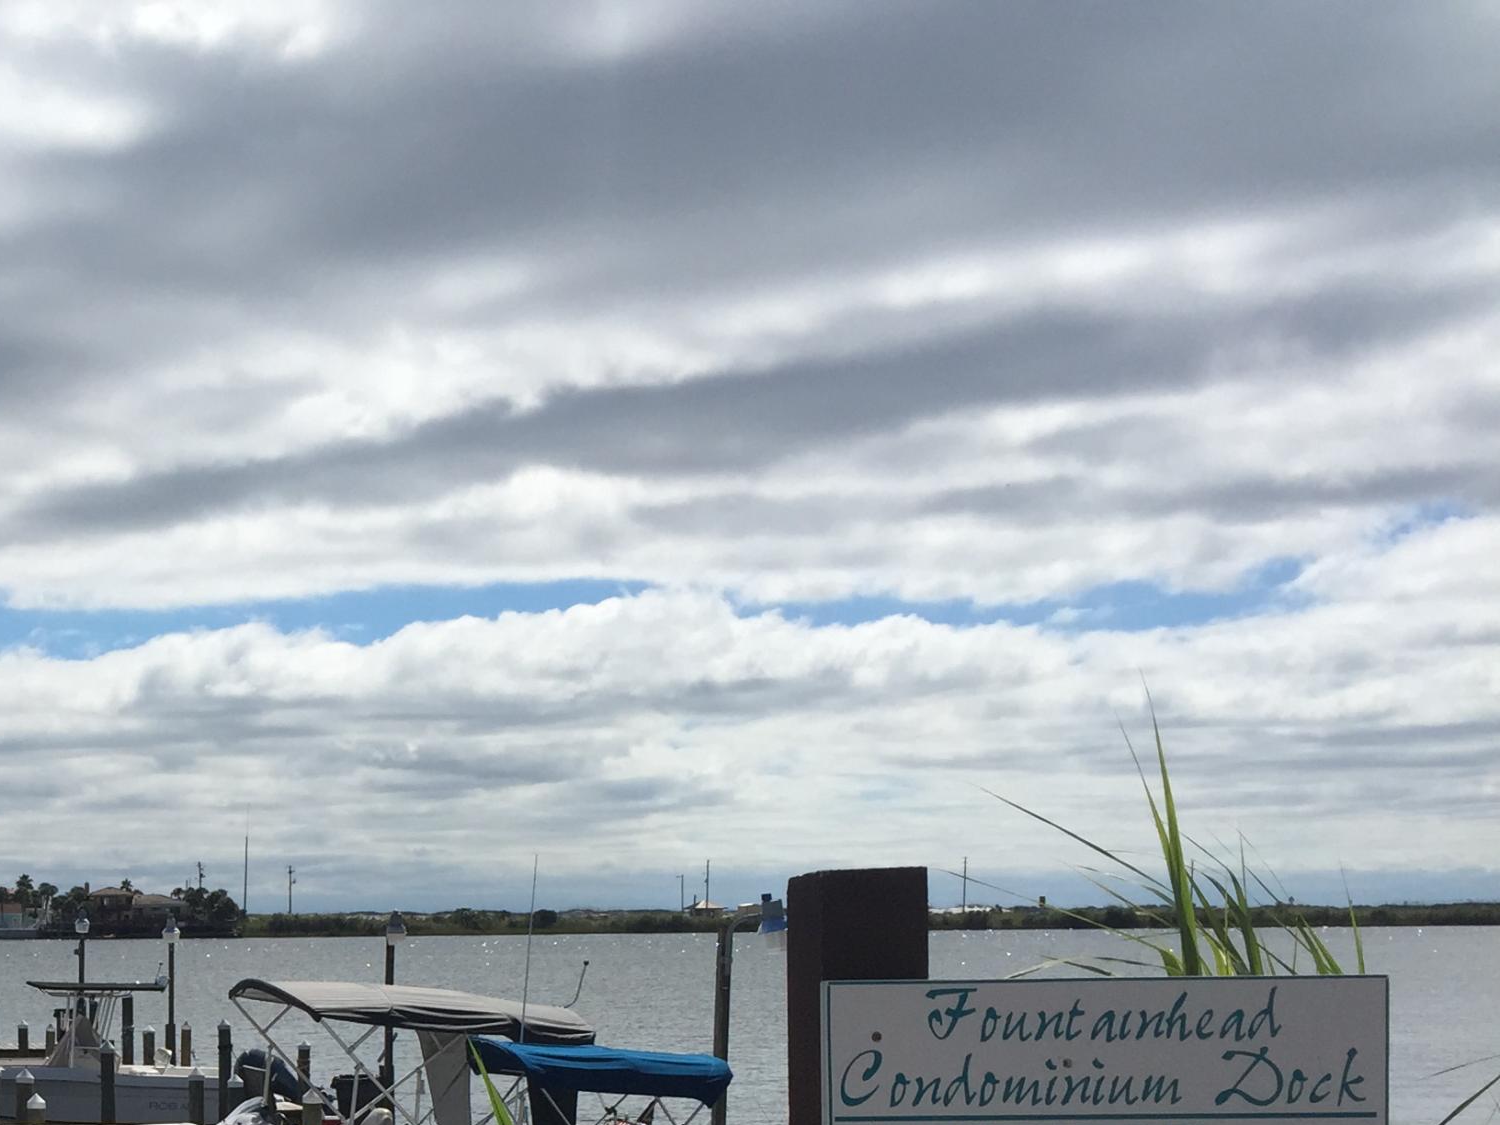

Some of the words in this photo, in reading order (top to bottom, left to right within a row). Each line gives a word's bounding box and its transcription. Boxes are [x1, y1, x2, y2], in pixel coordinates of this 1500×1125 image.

[926, 987, 1281, 1042] Fountainhead
[841, 1050, 1181, 1107] Condominium
[1215, 1047, 1365, 1106] Dock
